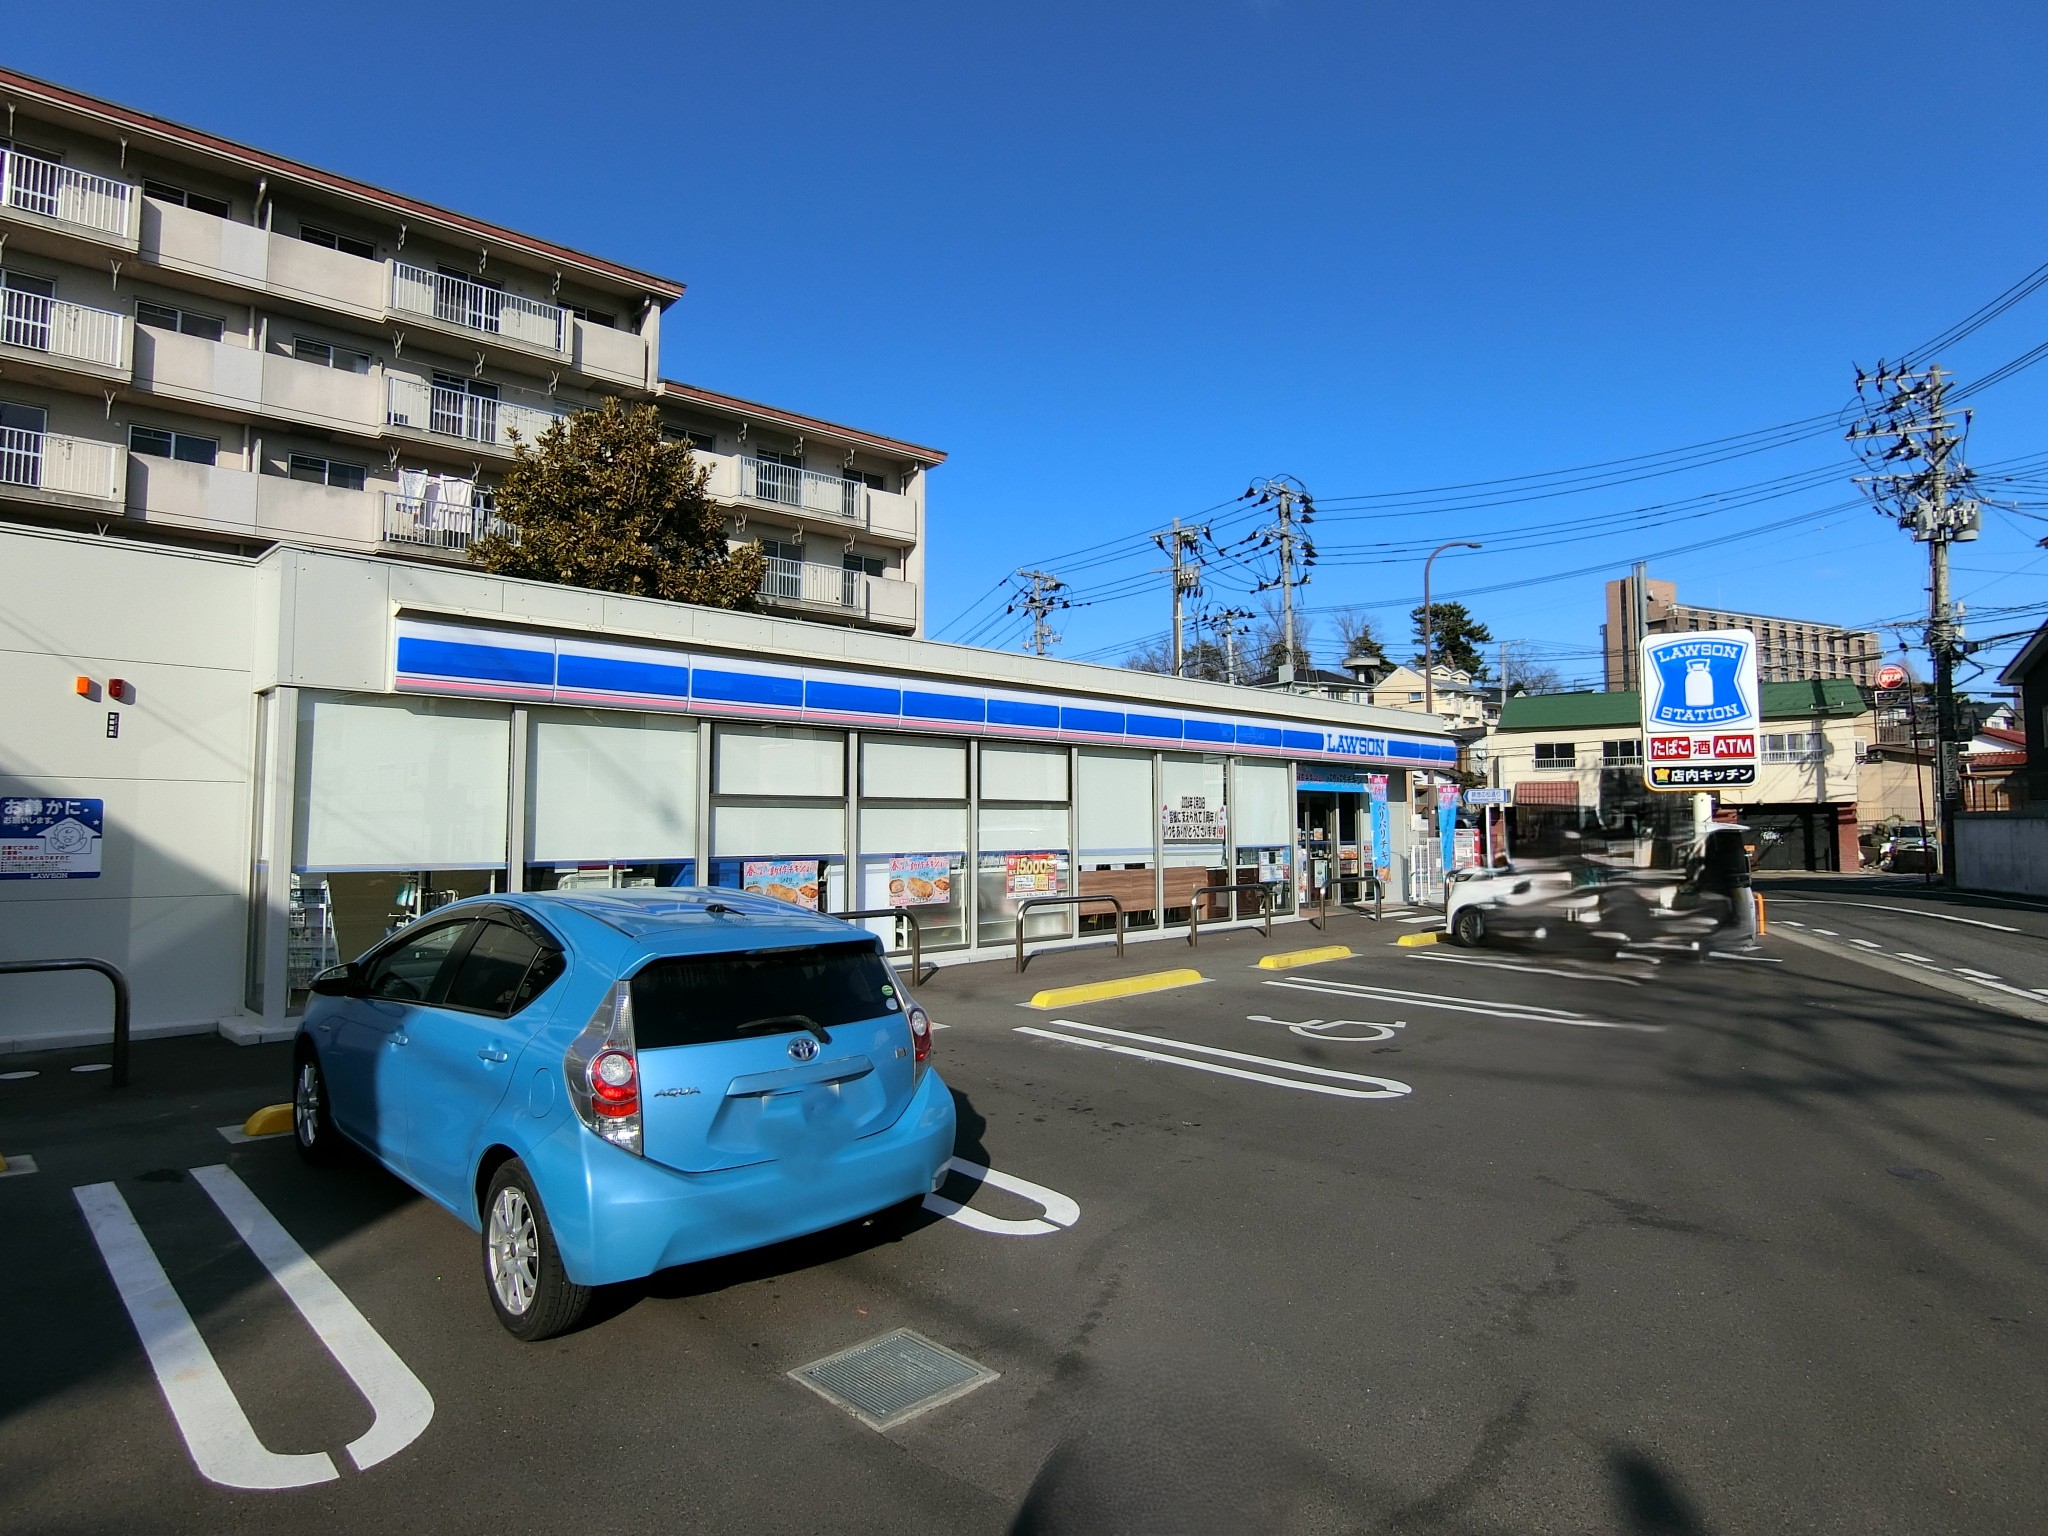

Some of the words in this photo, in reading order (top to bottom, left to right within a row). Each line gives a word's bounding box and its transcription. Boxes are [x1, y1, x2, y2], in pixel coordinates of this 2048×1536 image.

[1657, 644, 1738, 663] LAWSON
[1660, 703, 1740, 722] STATION
[1327, 733, 1385, 756] LAWSON
[1652, 740, 1690, 756] たばこ
[1693, 740, 1711, 755] 酒
[1715, 739, 1752, 754] ATM
[1671, 768, 1753, 782] 店内キッチン
[4, 799, 81, 815] お静かに
[3, 816, 55, 825] お願いします。
[654, 1087, 701, 1098] AQUA
